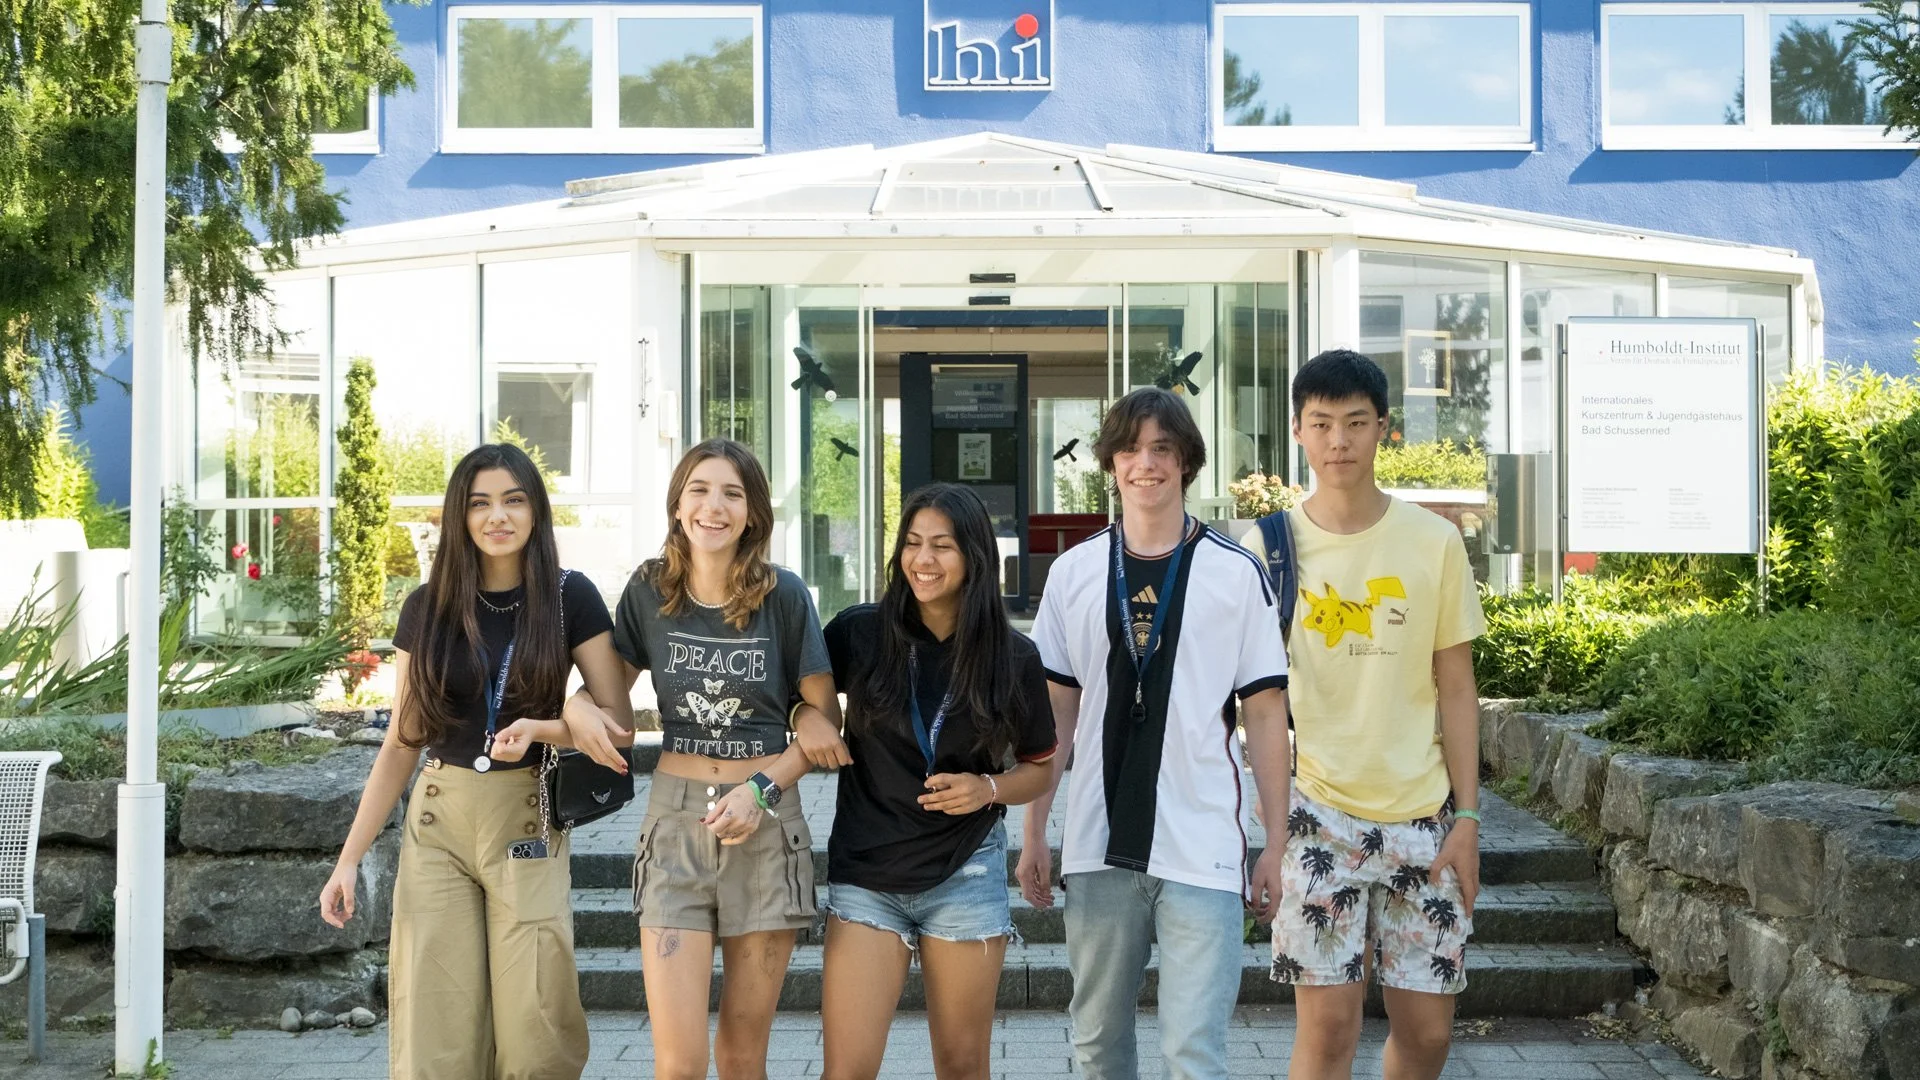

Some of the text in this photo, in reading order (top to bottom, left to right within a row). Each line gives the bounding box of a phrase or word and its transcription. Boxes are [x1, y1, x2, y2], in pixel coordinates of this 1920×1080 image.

[1611, 340, 1741, 355] Humboldt-Institut
[1582, 396, 1653, 405] Internationales
[1582, 411, 1643, 420] Kurszentrum
[1647, 412, 1653, 420] &
[1582, 426, 1670, 435] Bad Schussenried
[664, 642, 767, 681] PEACE
[672, 737, 765, 758] FUTURE
